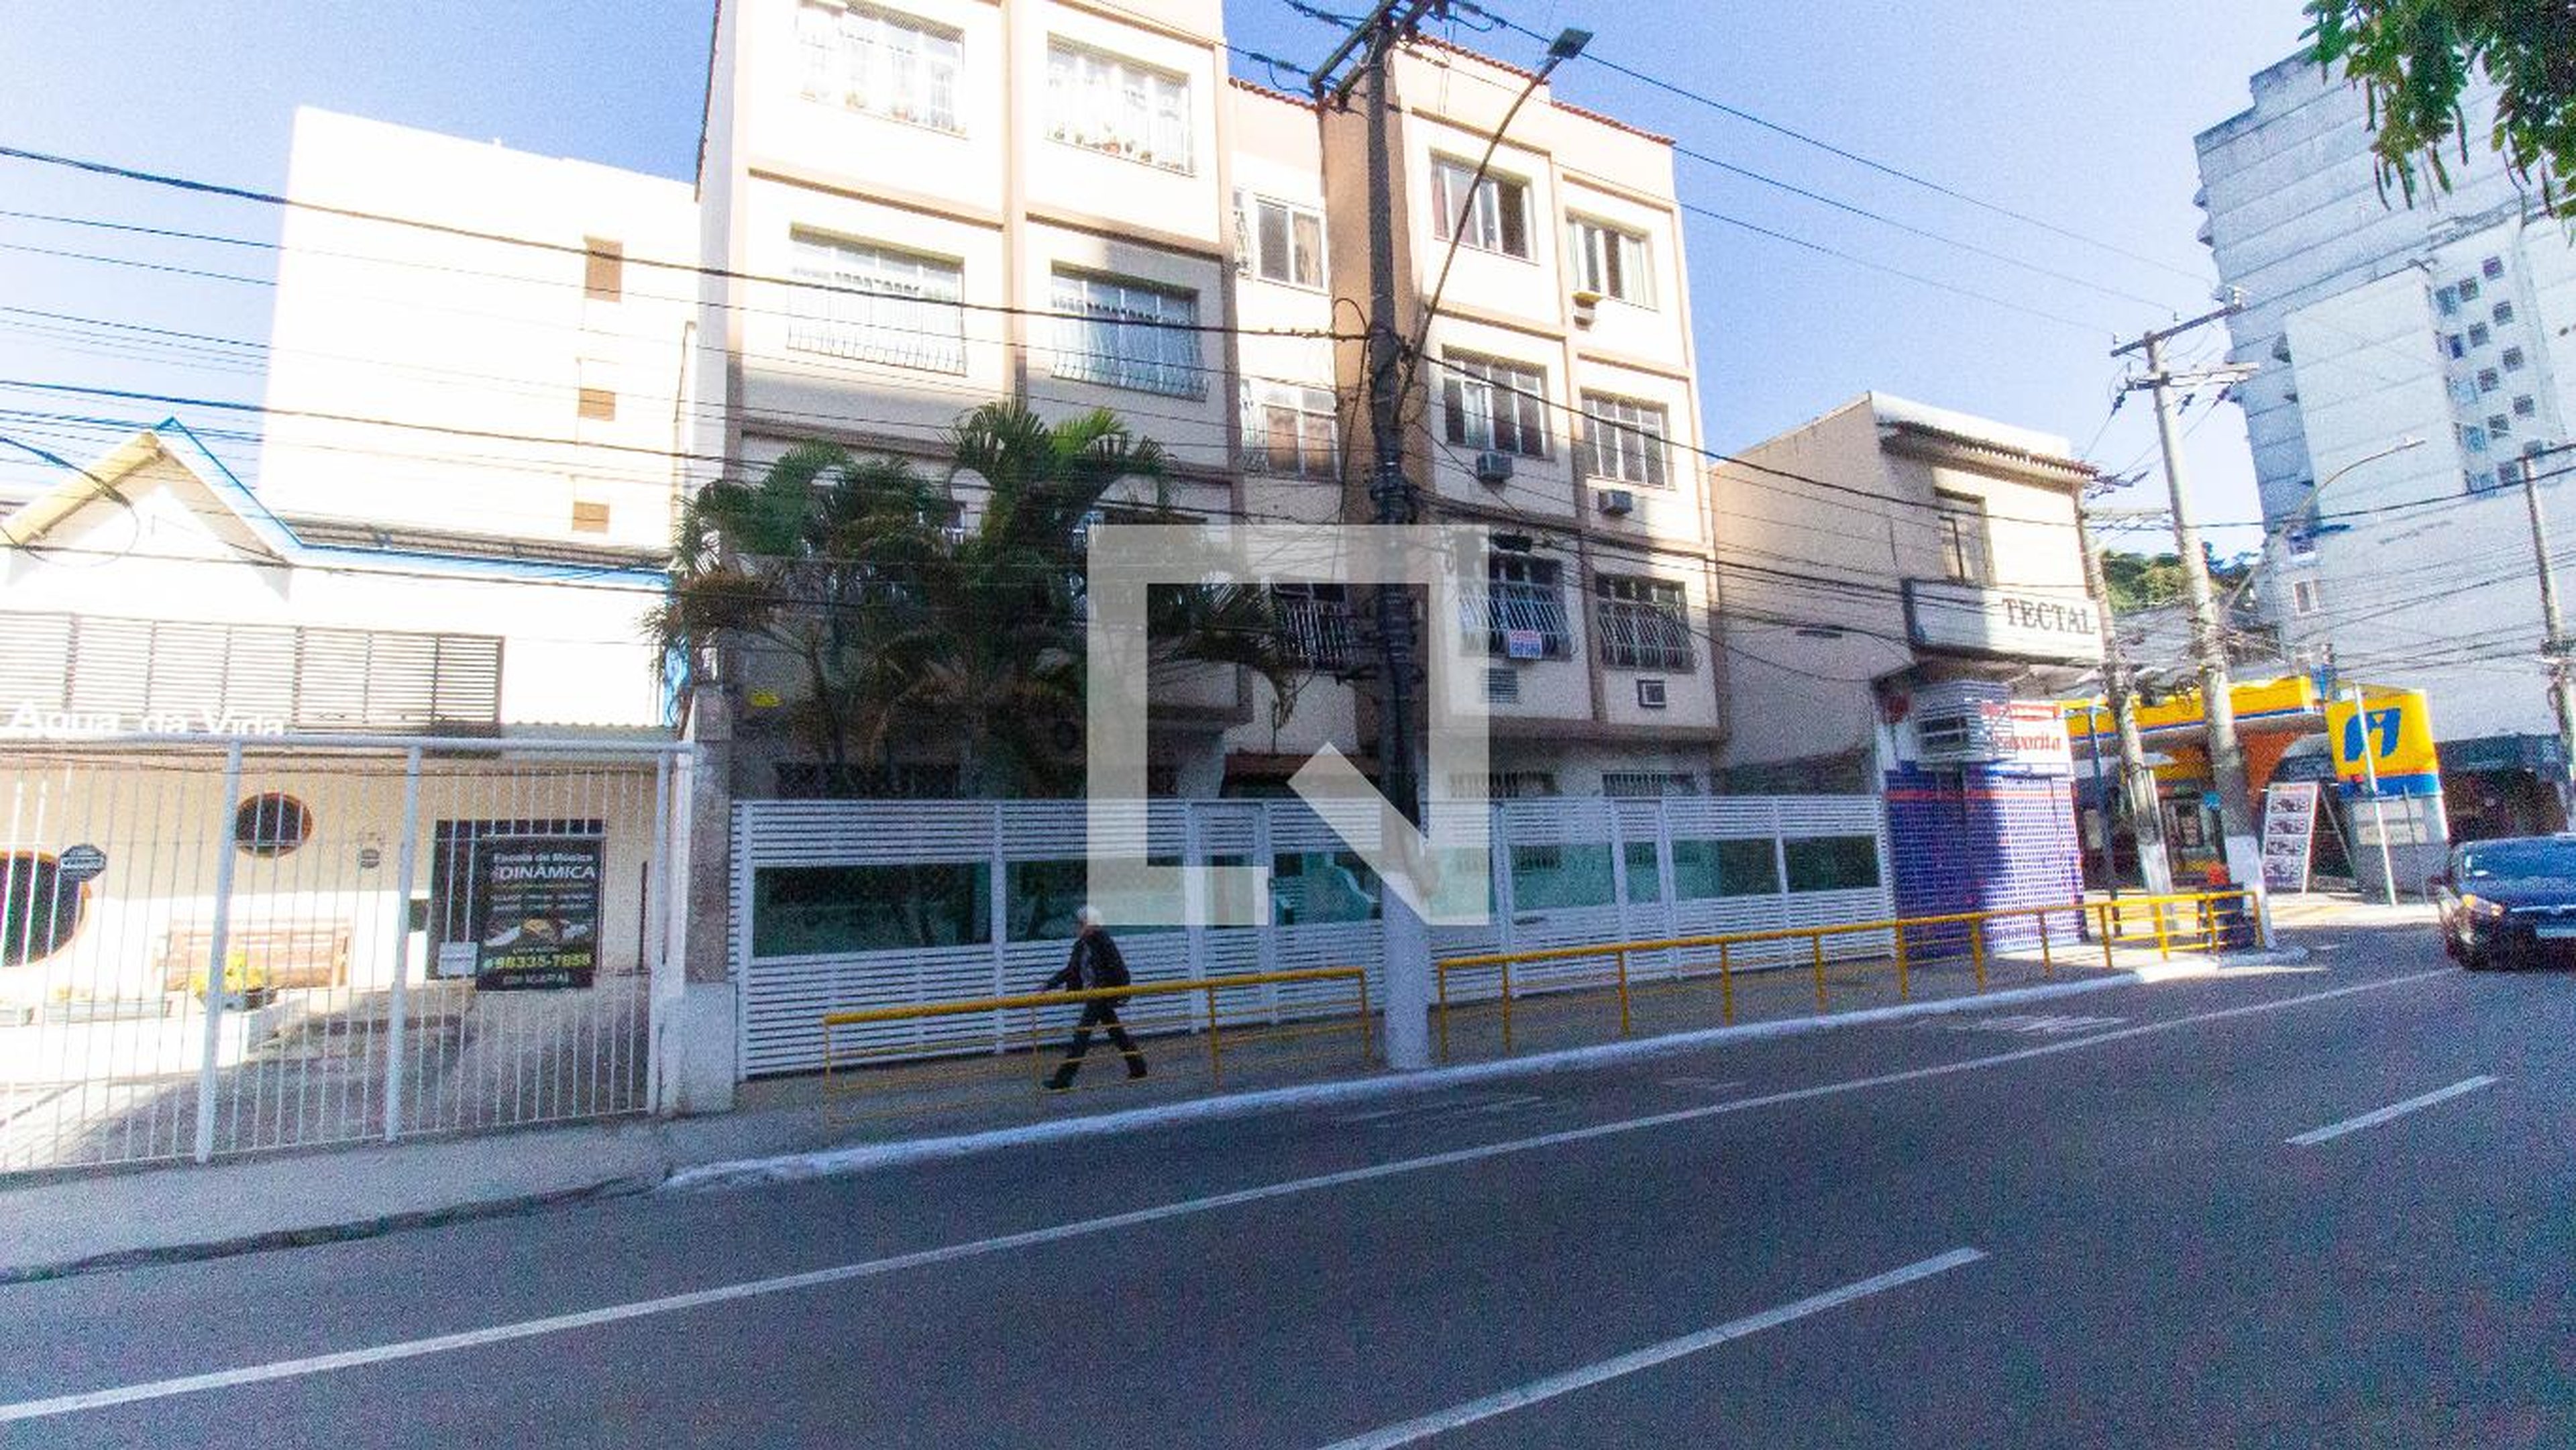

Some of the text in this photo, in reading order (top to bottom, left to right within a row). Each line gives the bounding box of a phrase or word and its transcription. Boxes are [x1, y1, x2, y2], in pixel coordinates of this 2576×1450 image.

[2002, 598, 2095, 635] TECTAL
[141, 710, 188, 734] da
[203, 707, 285, 735] Vida
